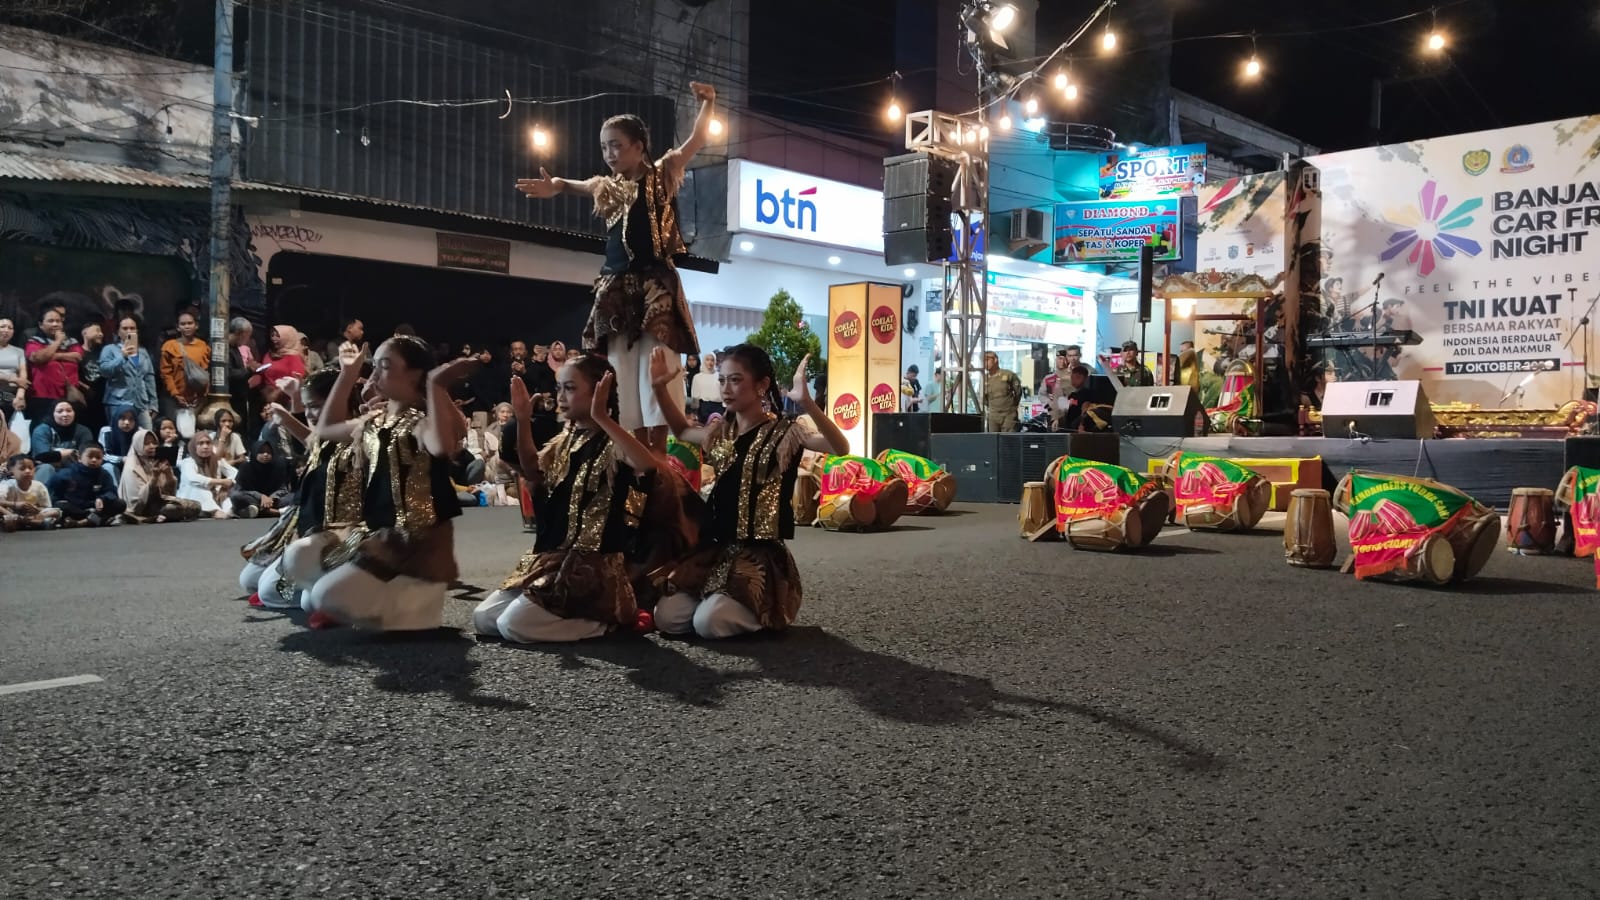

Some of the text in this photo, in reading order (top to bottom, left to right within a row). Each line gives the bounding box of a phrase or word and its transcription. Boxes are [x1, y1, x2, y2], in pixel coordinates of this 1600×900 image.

[1117, 156, 1189, 180] SPORT
[756, 178, 817, 233] btn
[1083, 207, 1149, 219] DIAMOND
[1493, 210, 1557, 235] CAR
[1116, 227, 1153, 236] SANDAL
[1085, 238, 1145, 249] TAS & KOPER
[1493, 231, 1588, 259] NIGHT
[1404, 272, 1597, 295] FEEL THE VIBE
[1443, 294, 1562, 321] TNI KUAT
[834, 318, 859, 334] COKLAT
[871, 315, 895, 327] COKLAT
[1443, 317, 1562, 335] BERSAMA RAKYAT
[843, 327, 858, 338] KITA
[880, 323, 894, 333] KITA
[1443, 333, 1563, 347] INDONESIA BERDAULAT
[1453, 344, 1552, 356] ADIL DAN MAKMUR
[1452, 363, 1463, 374] 17
[1465, 362, 1522, 373] OKTOBER
[871, 392, 893, 405] COKLAT
[879, 400, 894, 410] KITA
[833, 401, 859, 415] COKLAT
[842, 410, 858, 420] KITA
